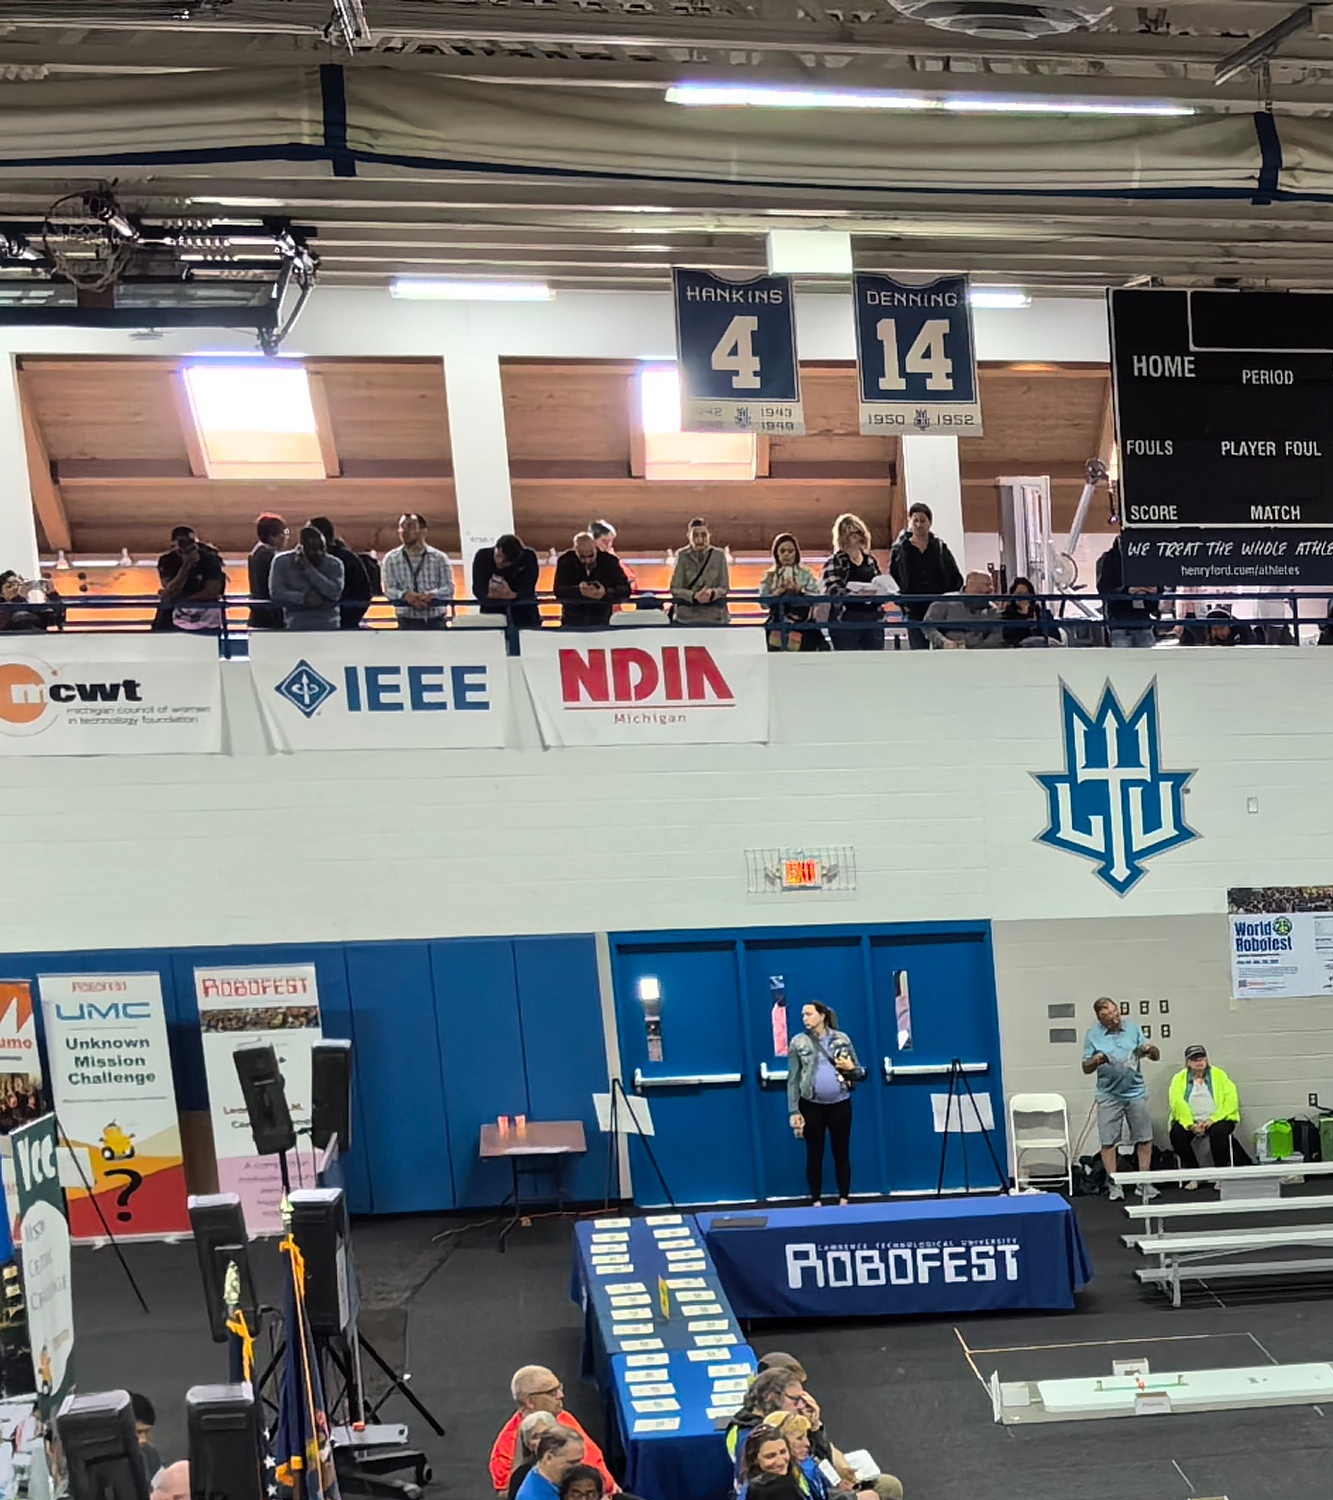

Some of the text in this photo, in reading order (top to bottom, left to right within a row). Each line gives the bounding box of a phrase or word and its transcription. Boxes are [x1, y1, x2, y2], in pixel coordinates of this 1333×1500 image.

[686, 285, 783, 304] HANKINS
[866, 290, 958, 307] DENNING
[711, 315, 761, 389] 4
[876, 318, 954, 390] 14
[1133, 355, 1196, 377] HOME
[1242, 369, 1294, 385] PERIOD
[867, 413, 975, 426] 1950 1952
[1126, 440, 1174, 455] FOULS
[1221, 441, 1322, 456] PLAYER FOUL
[1130, 505, 1178, 520] SCORE
[1250, 505, 1301, 520] MATCH
[1128, 542, 1150, 556] WE
[1156, 542, 1203, 558] TREAT
[1206, 542, 1234, 557] THE
[1241, 541, 1289, 557] WHOLE
[558, 645, 735, 702] NDIA
[343, 665, 490, 712] IEEE
[613, 711, 687, 726] Michigan
[1235, 920, 1272, 936] World
[1236, 936, 1293, 952] Robofest
[55, 1002, 151, 1020] UMC
[65, 1037, 150, 1050] Unknown
[74, 1055, 146, 1068] Mission
[68, 1072, 156, 1086] Challenge
[785, 1243, 1020, 1289] ROBOFEST
